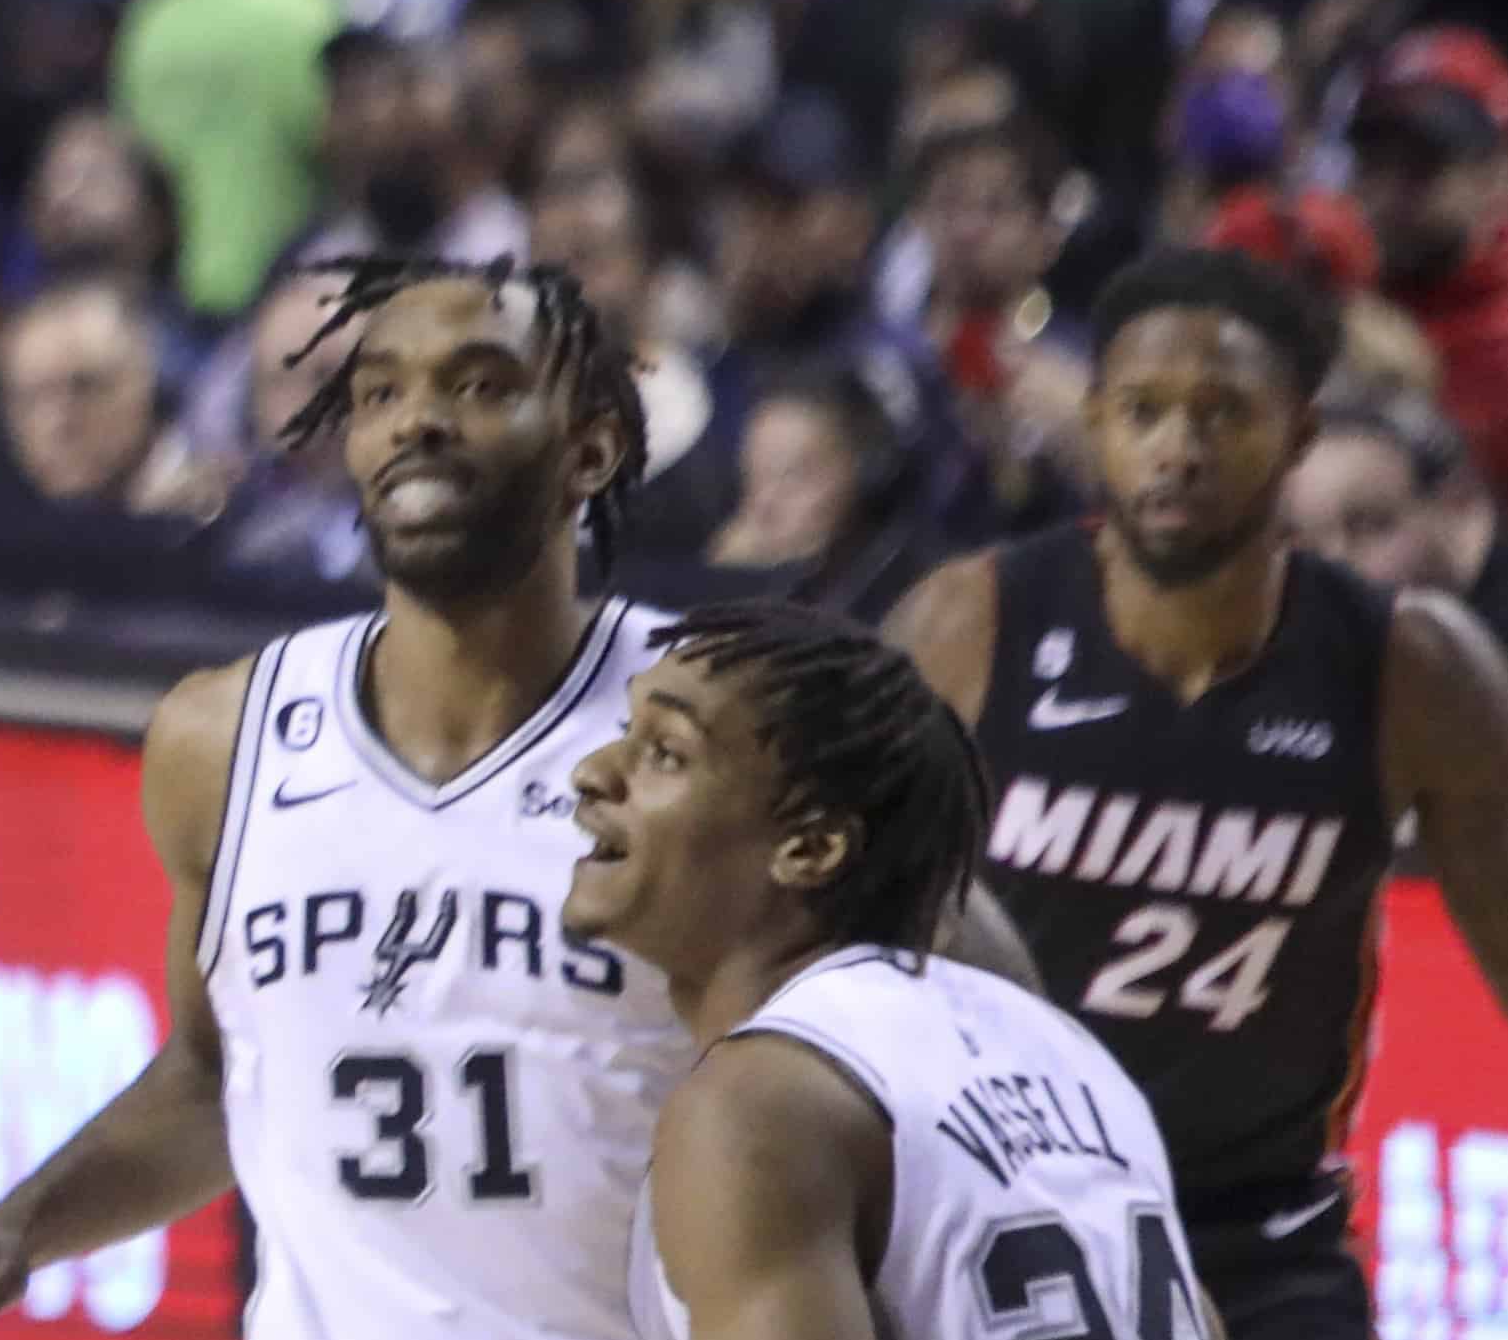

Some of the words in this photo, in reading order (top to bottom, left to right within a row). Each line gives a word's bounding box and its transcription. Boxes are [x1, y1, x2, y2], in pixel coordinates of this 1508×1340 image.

[986, 777, 1343, 906] MIAMI
[244, 887, 625, 1016] SPURS
[1082, 905, 1292, 1033] 24
[328, 1044, 539, 1206] 31
[936, 1072, 1131, 1190] VASSELL
